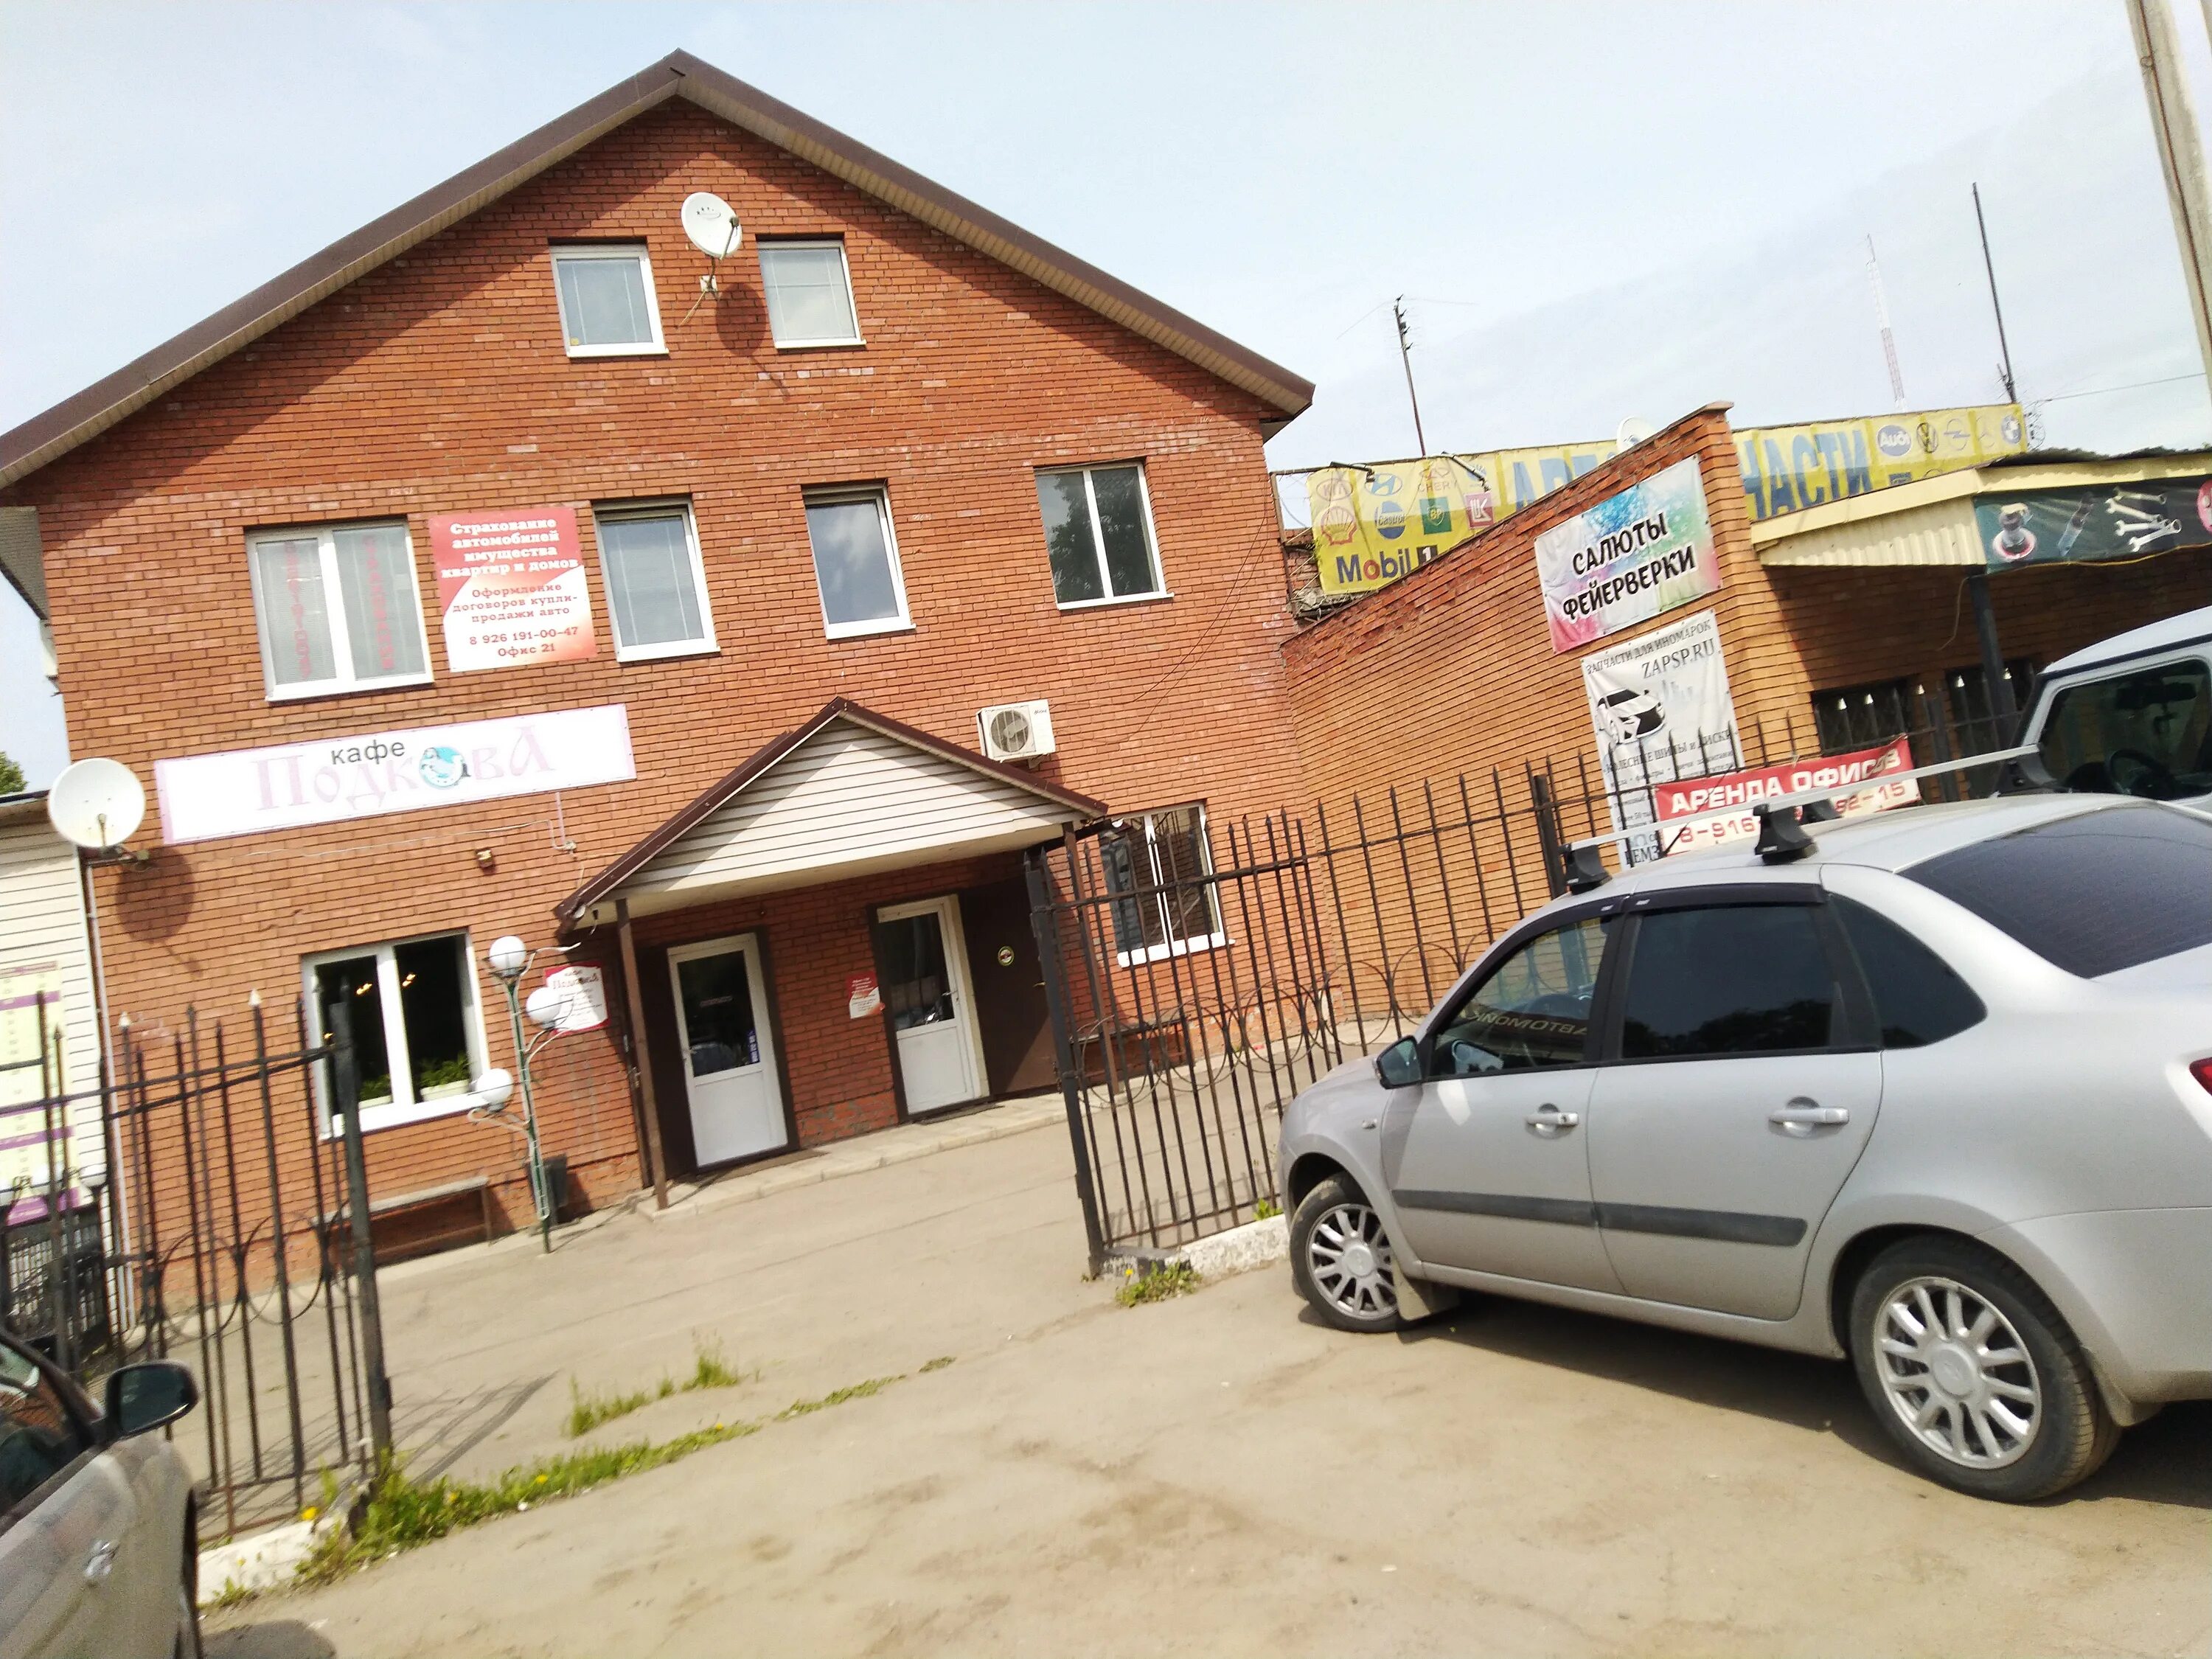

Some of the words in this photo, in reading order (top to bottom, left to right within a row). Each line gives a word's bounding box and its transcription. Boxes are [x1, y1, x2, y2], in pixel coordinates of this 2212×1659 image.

[450, 518, 557, 536] Страхование
[452, 529, 560, 549] автомобилей
[1572, 512, 1669, 575] САЛЮТЫ
[464, 546, 558, 563] имущества
[441, 563, 511, 579] квартир
[514, 563, 525, 572] и
[529, 558, 579, 572] домов
[1335, 547, 1411, 585] Mobil
[472, 583, 563, 599] Оформление
[1562, 545, 1697, 620] ФЕЙЕРВЕРКИ
[453, 599, 526, 613] договоров
[531, 595, 578, 607] купли-
[471, 611, 535, 624] продажи
[540, 606, 570, 617] авто
[469, 636, 478, 645] 8
[482, 633, 508, 644] 926
[512, 626, 579, 641] 191-00-47
[498, 645, 537, 658] Офис
[541, 643, 555, 653] 21
[1585, 650, 1635, 675] ЗАПЧАСТИ
[1633, 642, 1655, 659] ДЛЯ
[1654, 619, 1712, 651] ИНОМАРОК
[1641, 637, 1715, 680] ZAPSP.RU
[330, 739, 406, 765] кафе
[1670, 776, 1787, 815] АРЕНДА
